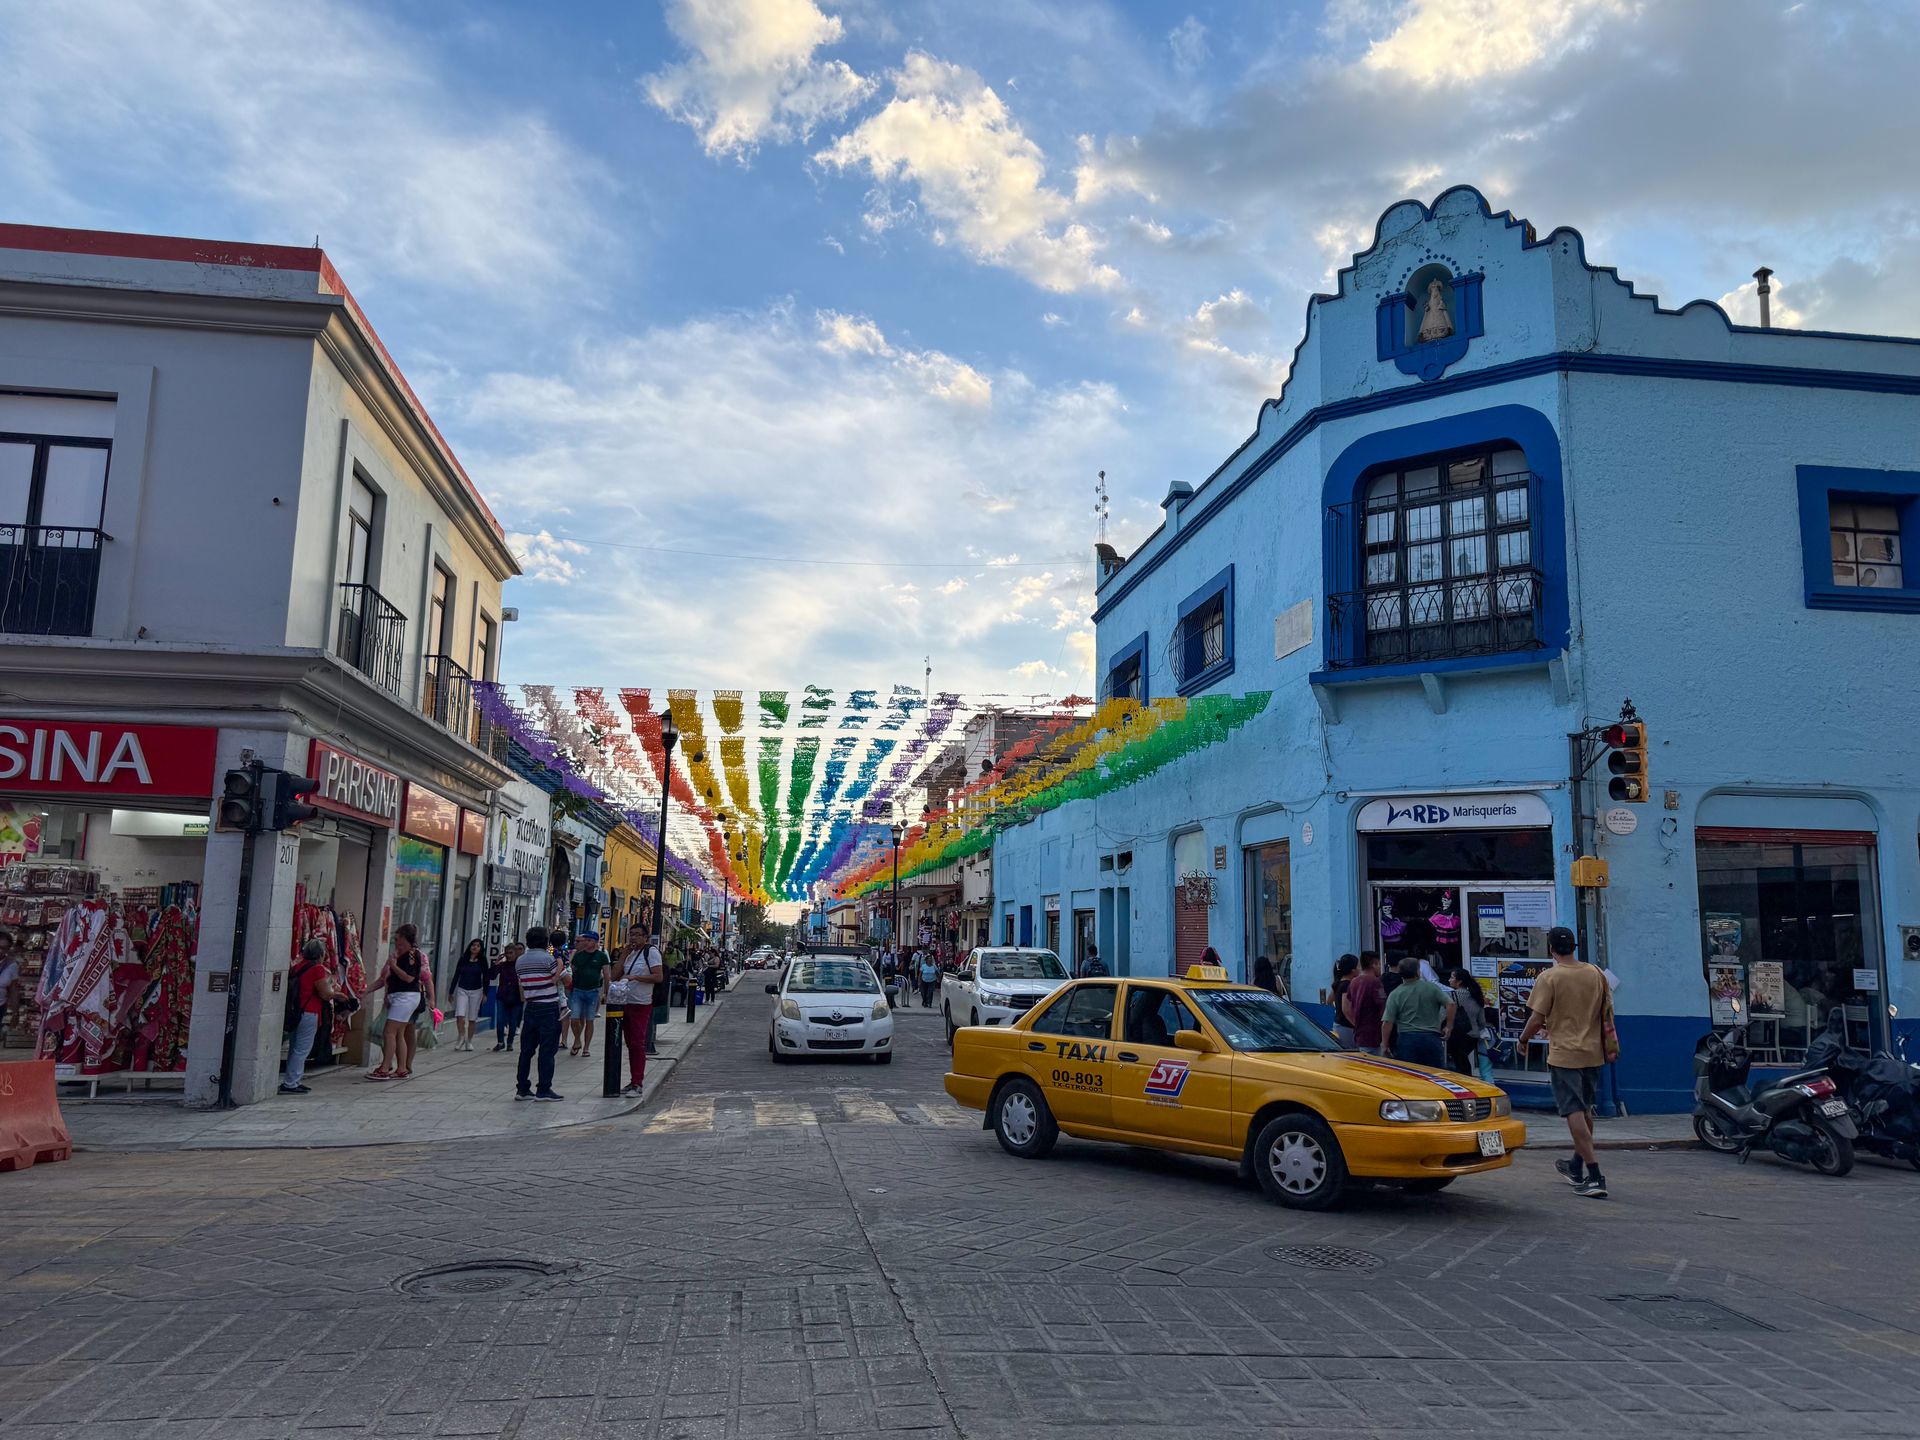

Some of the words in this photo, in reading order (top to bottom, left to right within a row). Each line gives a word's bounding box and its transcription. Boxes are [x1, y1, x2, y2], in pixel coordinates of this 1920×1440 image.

[325, 751, 399, 821] PARISINA
[1453, 803, 1517, 819] Marisquerías
[280, 845, 294, 866] 201
[1202, 967, 1221, 978] TAXI
[1056, 1042, 1107, 1063] TAXI
[1052, 1069, 1103, 1087] 00-803
